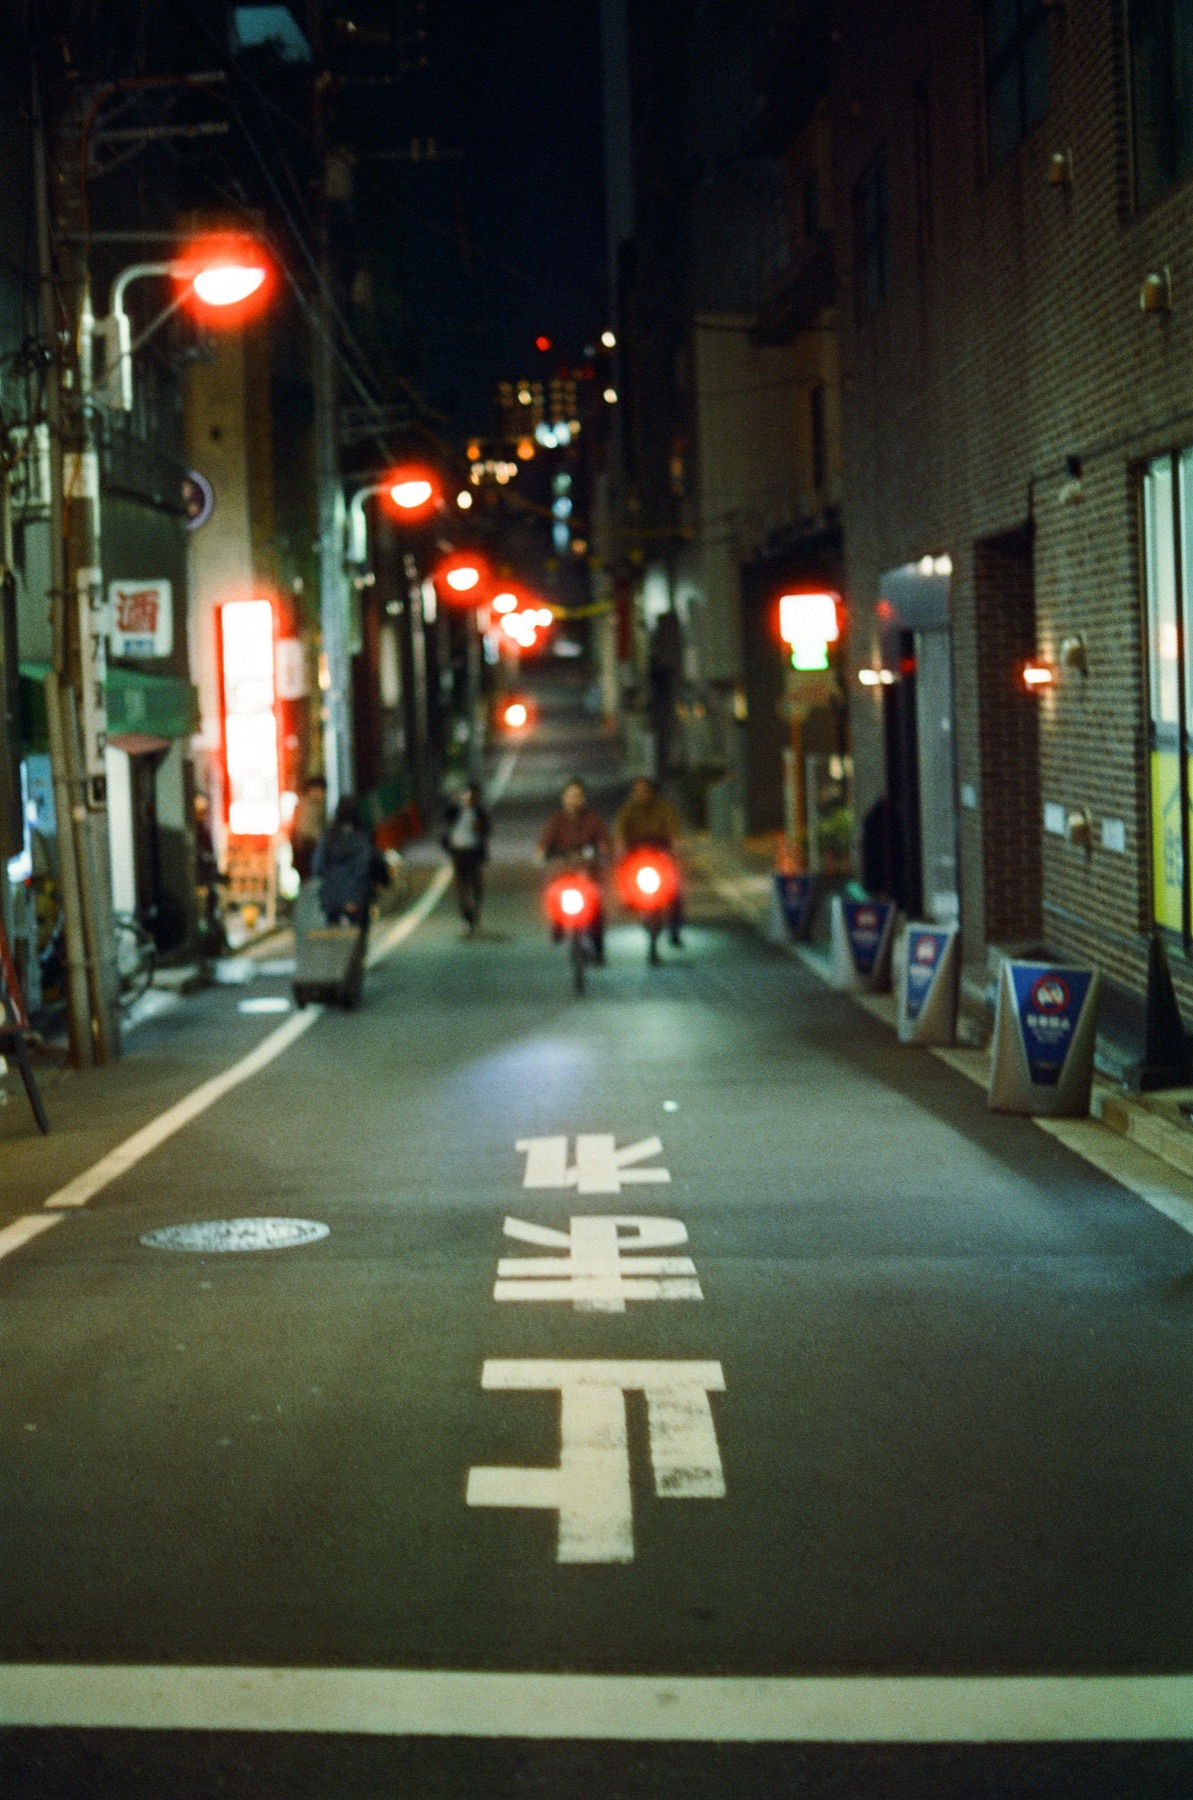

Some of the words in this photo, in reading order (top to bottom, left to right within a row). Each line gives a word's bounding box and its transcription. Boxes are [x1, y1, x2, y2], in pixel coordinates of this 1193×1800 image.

[116, 590, 159, 633] 酒
[466, 1133, 726, 1564] 止まれ
